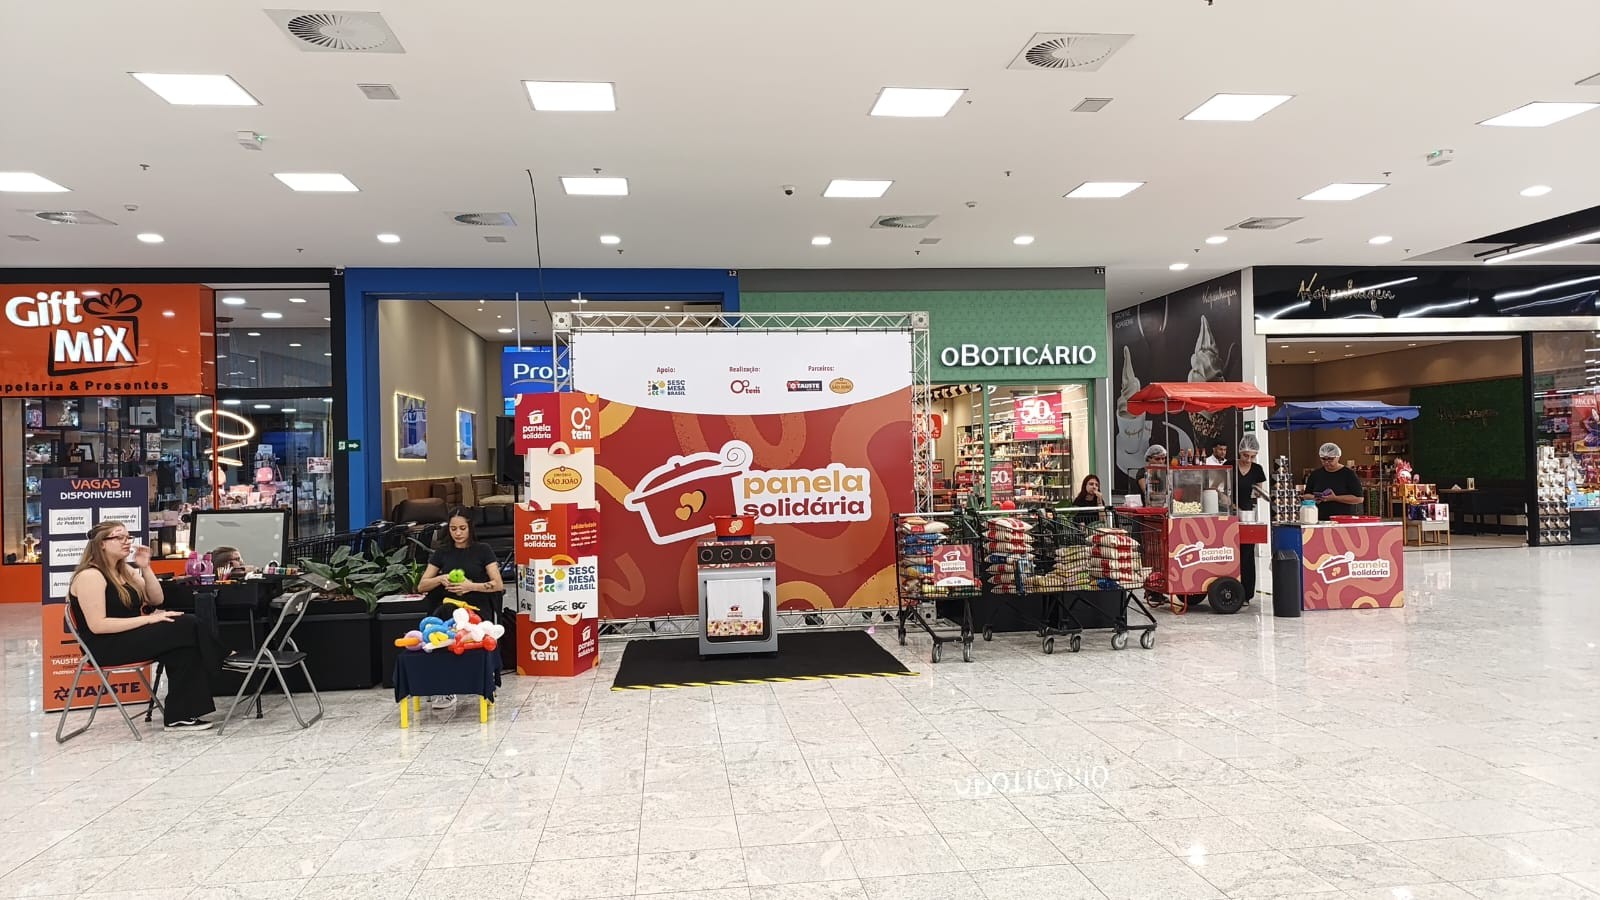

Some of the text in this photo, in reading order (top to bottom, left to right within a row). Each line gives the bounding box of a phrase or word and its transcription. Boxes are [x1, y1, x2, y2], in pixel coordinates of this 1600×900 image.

[5, 290, 83, 328] Gift
[53, 324, 136, 363] MiX
[656, 366, 676, 374] Apoio:
[69, 381, 79, 391] &
[85, 380, 169, 392] Presentes
[522, 424, 551, 434] panela
[571, 428, 592, 440] tem
[72, 479, 120, 490] VAGAS
[547, 477, 579, 485] SÃO JOÃO
[743, 470, 864, 499] panela
[61, 491, 131, 500] DISPONIVEIS!!!
[743, 496, 865, 518] solidária
[524, 533, 556, 542] panela
[524, 539, 556, 548] solidária
[1202, 547, 1232, 556] panela
[1202, 553, 1233, 562] solidária
[568, 566, 595, 575] SESC
[1351, 560, 1388, 571] panela
[1351, 566, 1389, 576] solidária
[568, 575, 595, 584] MESA
[530, 649, 558, 661] tem
